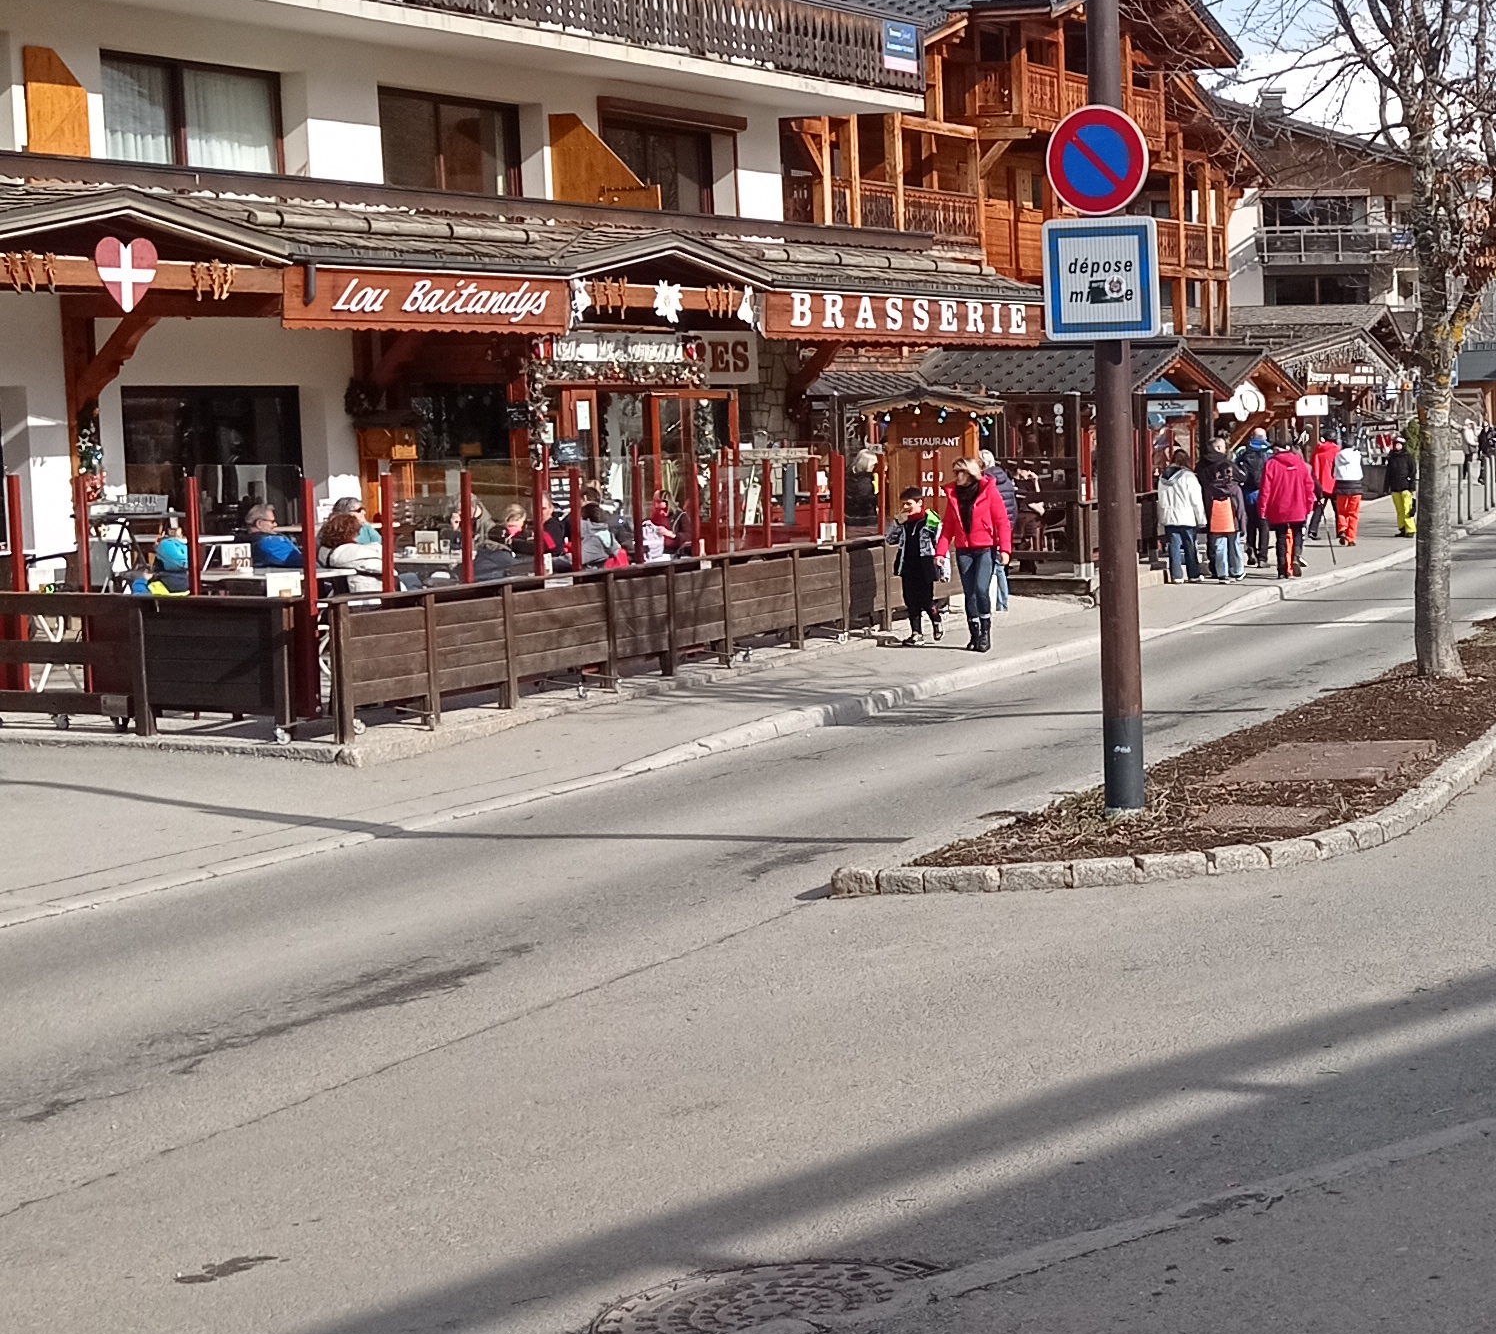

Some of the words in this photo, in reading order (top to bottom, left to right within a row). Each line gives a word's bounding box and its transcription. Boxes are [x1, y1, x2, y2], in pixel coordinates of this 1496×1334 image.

[1068, 257, 1133, 278] dépose
[332, 278, 391, 313] Lou
[401, 279, 551, 323] Baitandys
[1069, 288, 1133, 302] mie
[791, 292, 1027, 335] BRASSERIE
[902, 437, 960, 446] RESTAURANT
[236, 558, 250, 567] 20
